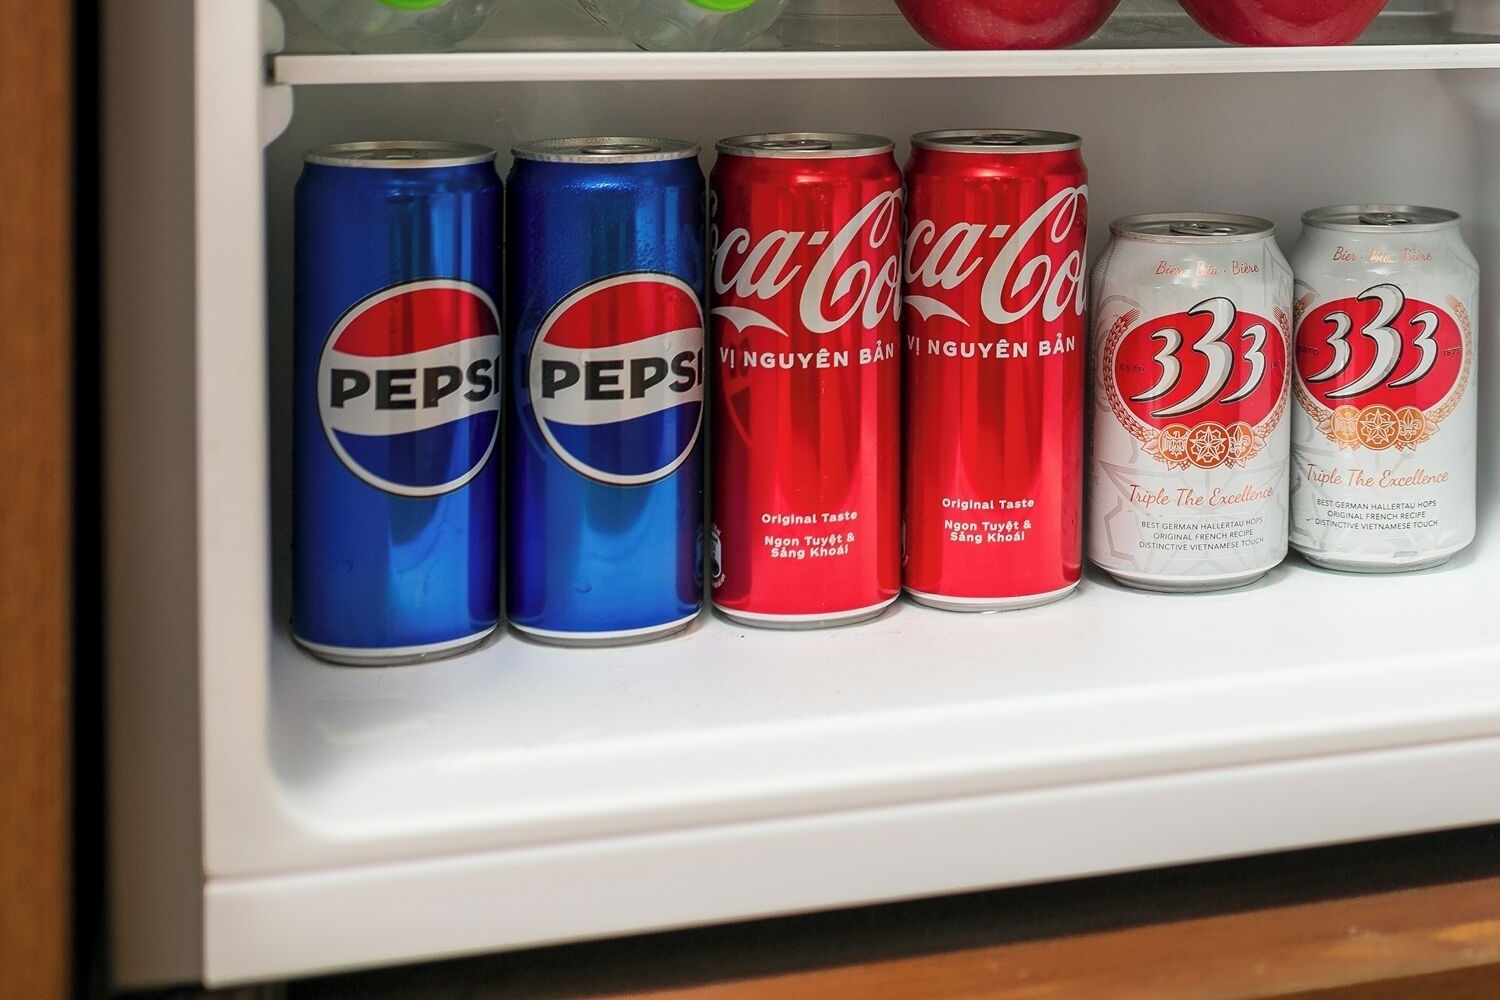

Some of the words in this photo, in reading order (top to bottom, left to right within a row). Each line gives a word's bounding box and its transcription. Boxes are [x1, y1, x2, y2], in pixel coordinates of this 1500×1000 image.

[1332, 246, 1356, 262] Bier
[1231, 260, 1260, 276] Bière
[906, 334, 920, 356] VỊ
[927, 338, 1028, 359] NGUYÊN
[1038, 332, 1076, 357] BẢN
[1306, 283, 1440, 399] 333
[719, 346, 735, 369] VỊ
[743, 347, 849, 369] NGUYÊN
[859, 339, 895, 365] BẢN
[1130, 296, 1268, 418] 333
[1306, 463, 1342, 488] Triple
[1347, 468, 1375, 488] The
[1378, 468, 1450, 489] Excellence
[1128, 484, 1170, 509] Triple
[1176, 488, 1205, 507] The
[1208, 483, 1275, 507] Excellence
[942, 497, 994, 511] Original
[998, 498, 1035, 510] Taste
[1316, 498, 1334, 507] BEST
[1335, 501, 1369, 510] GERMAN
[1371, 502, 1415, 510] HALLERTAU
[1417, 500, 1437, 508] HOPS
[761, 513, 817, 526] Original
[821, 510, 858, 523] Taste
[1141, 521, 1160, 529] BEST
[1162, 522, 1198, 530] GERMAN
[1200, 521, 1244, 530] HALLERTAU
[1245, 516, 1264, 526] HOPS
[1327, 510, 1364, 520] ORIGINAL
[1366, 513, 1398, 521] FRENCH
[1400, 511, 1427, 520] RECIPE
[944, 519, 978, 532] Ngon
[982, 520, 1020, 533] Tuyệt
[1023, 519, 1032, 530] &
[1315, 518, 1359, 530] DISTINCTIVE
[1361, 522, 1411, 531] VIETNAMESE
[1413, 519, 1438, 529] TOUCH
[764, 535, 800, 548] Ngon
[804, 533, 843, 547] Tuyệt
[846, 532, 855, 542] &
[987, 531, 1025, 543] Khoái
[1153, 532, 1192, 541] ORIGINAL
[1195, 532, 1227, 541] FRENCH
[1229, 529, 1254, 539] RECIPE
[810, 544, 849, 558] Khoái
[1139, 541, 1188, 551] DISTINCTIVE
[1190, 542, 1239, 551] VIETNAMESE
[1241, 537, 1264, 547] TOUCH
